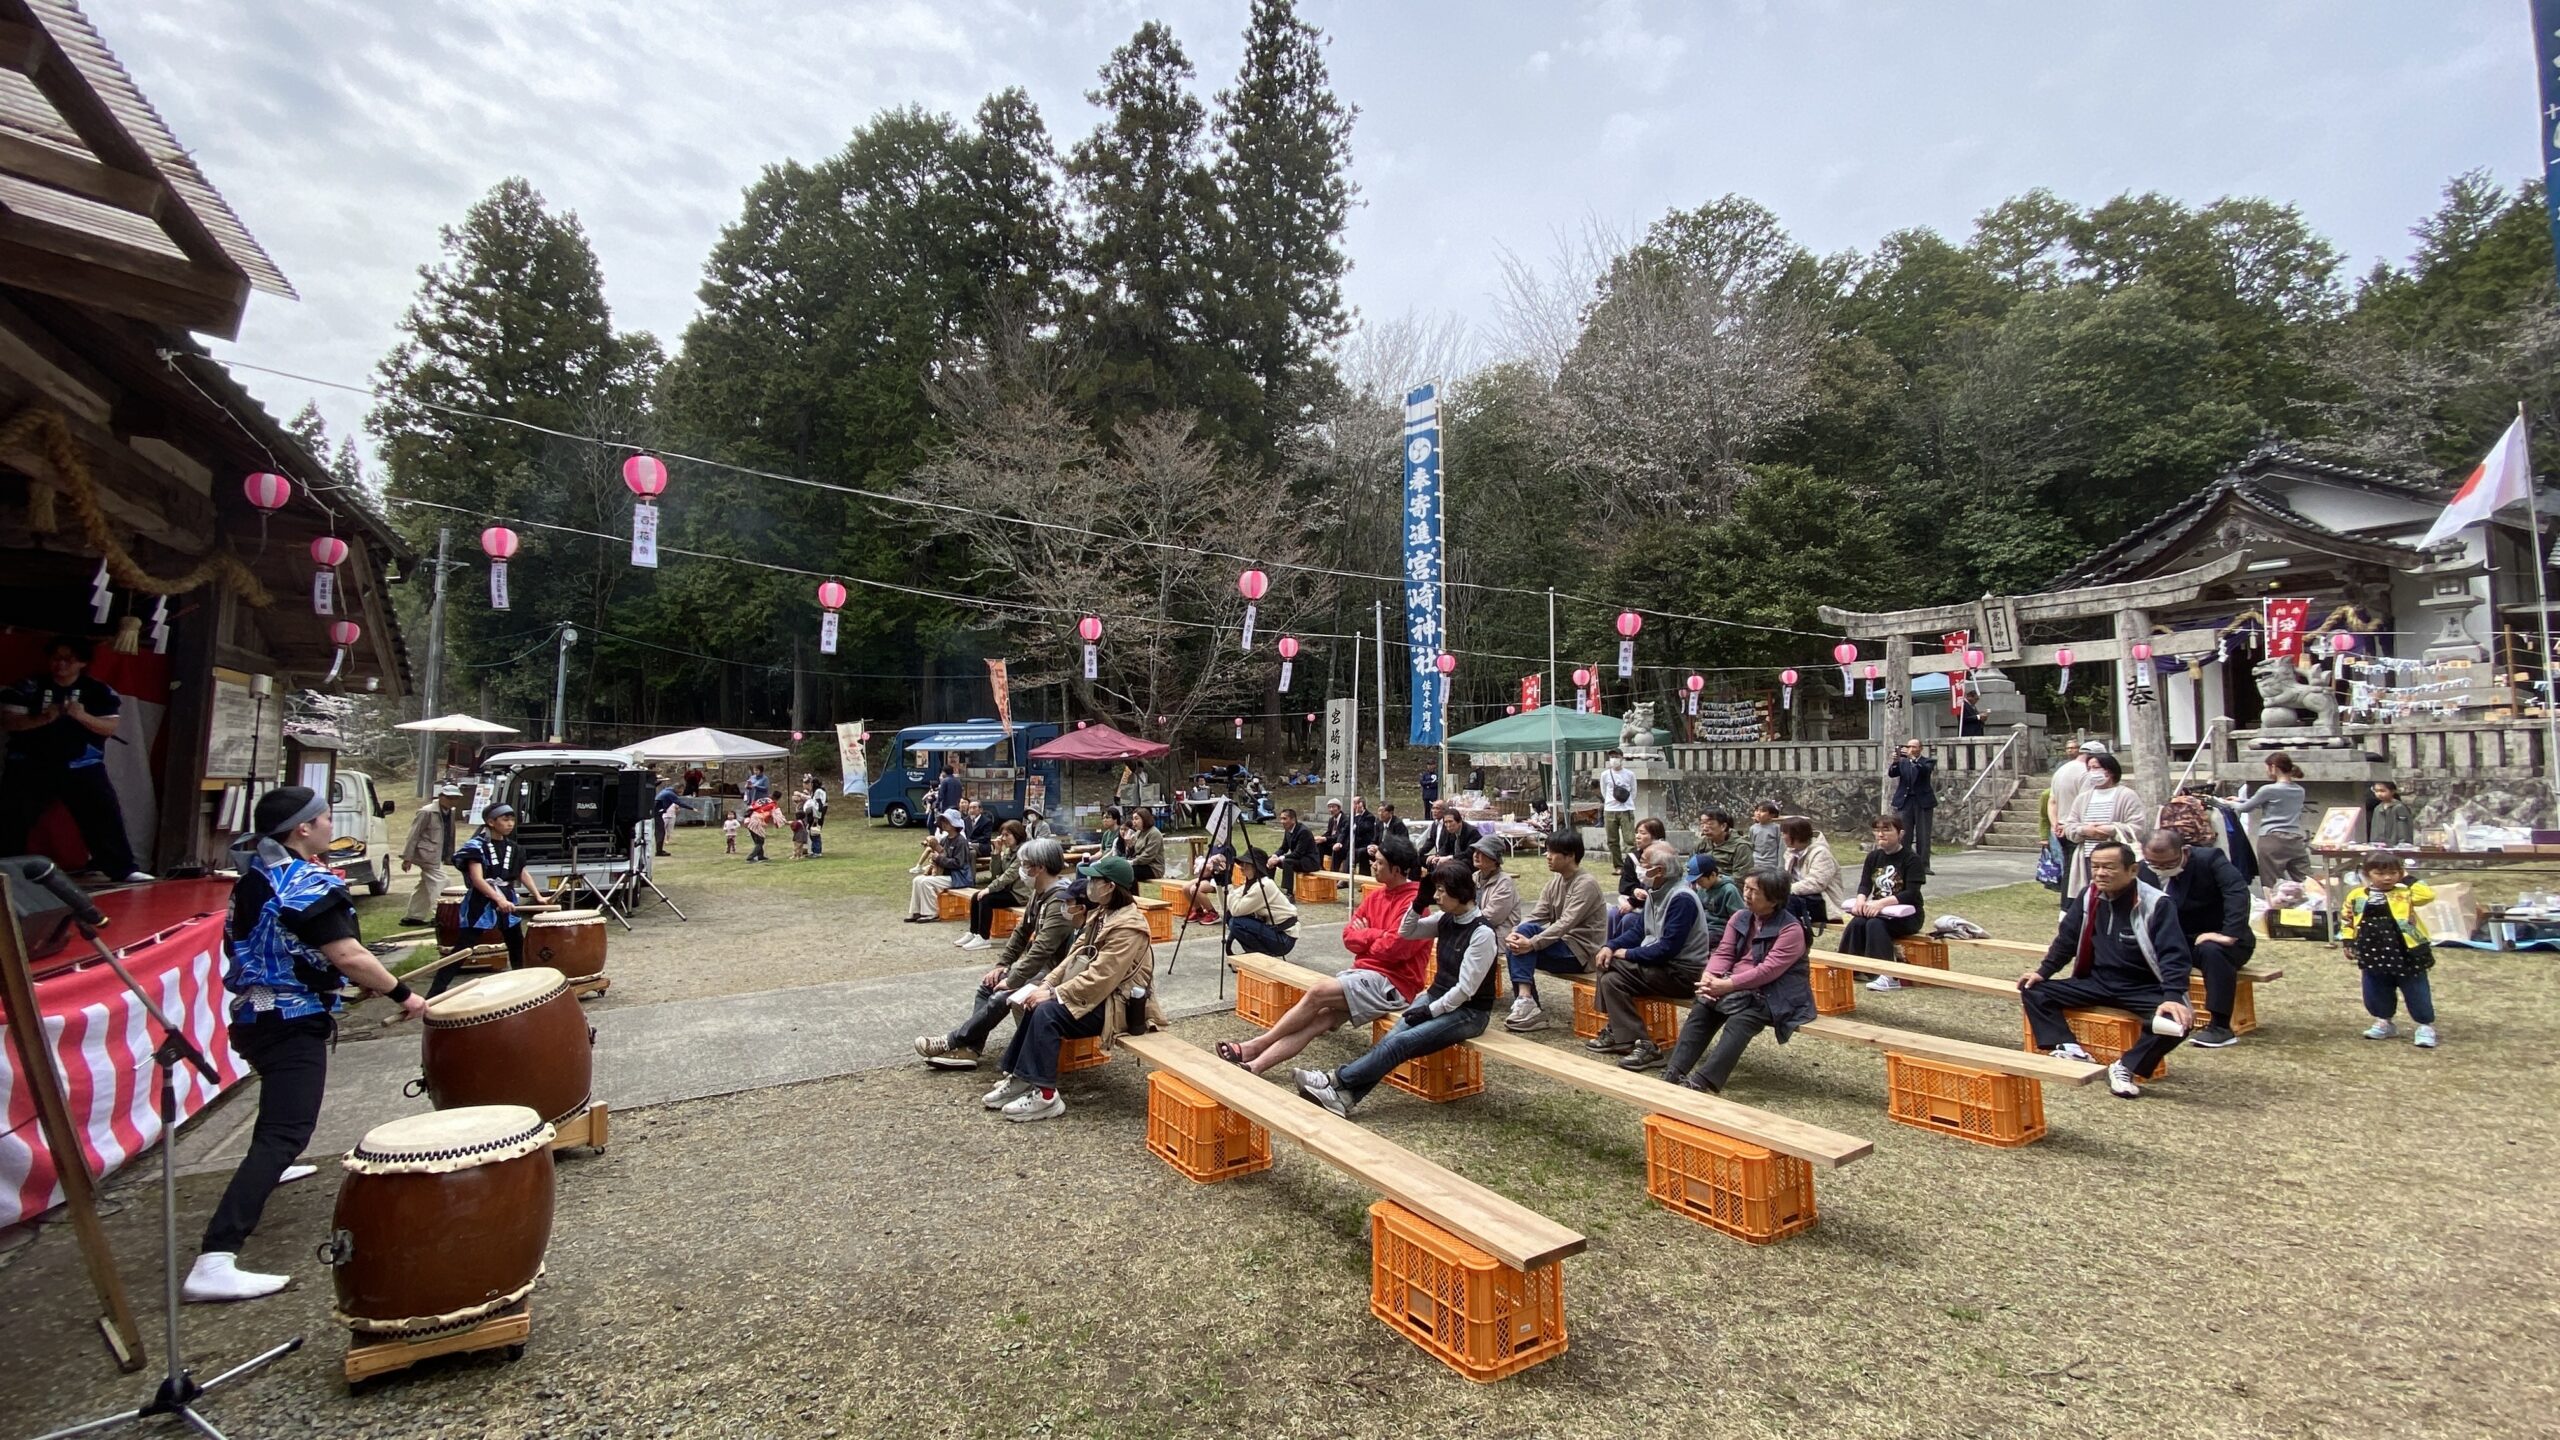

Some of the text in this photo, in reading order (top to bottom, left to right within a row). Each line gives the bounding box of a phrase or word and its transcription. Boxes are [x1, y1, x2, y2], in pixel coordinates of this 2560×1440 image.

[1407, 467, 1438, 676] 奉寄進宮崎神社
[1991, 611, 2006, 647] 宮崎神社
[1886, 690, 1903, 709] 納
[1329, 708, 1341, 785] 宮崎神社
